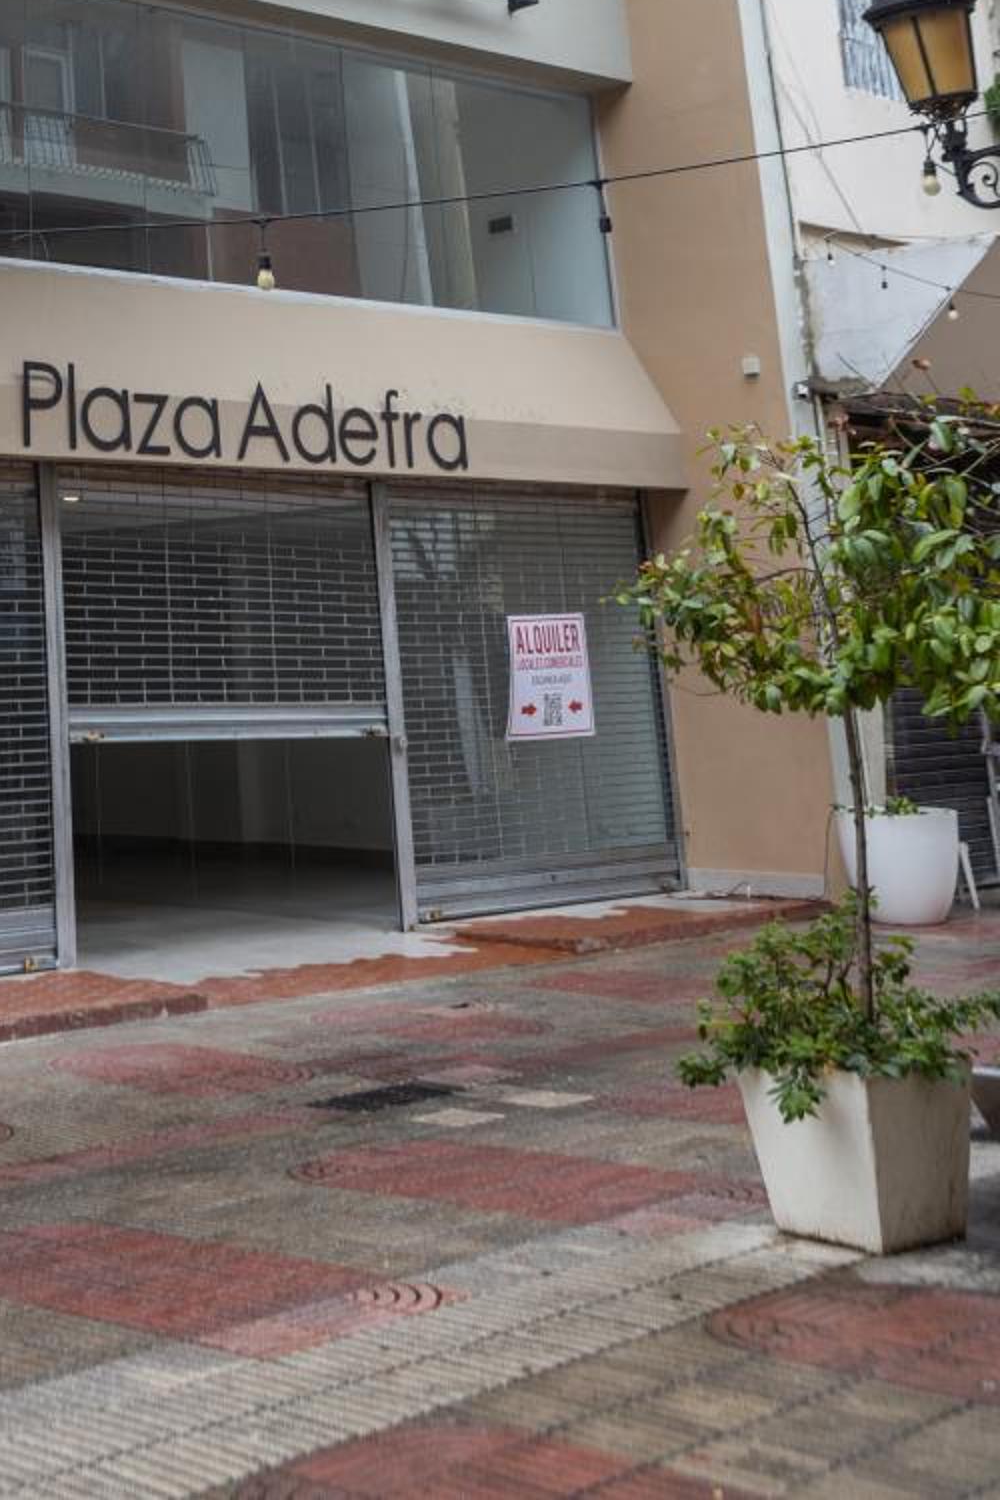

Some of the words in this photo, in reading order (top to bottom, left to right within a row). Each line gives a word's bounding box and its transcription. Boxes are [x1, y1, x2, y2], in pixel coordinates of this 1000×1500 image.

[22, 360, 222, 458] Plaza
[238, 381, 470, 471] Adefra
[517, 624, 580, 654] ALQUILER
